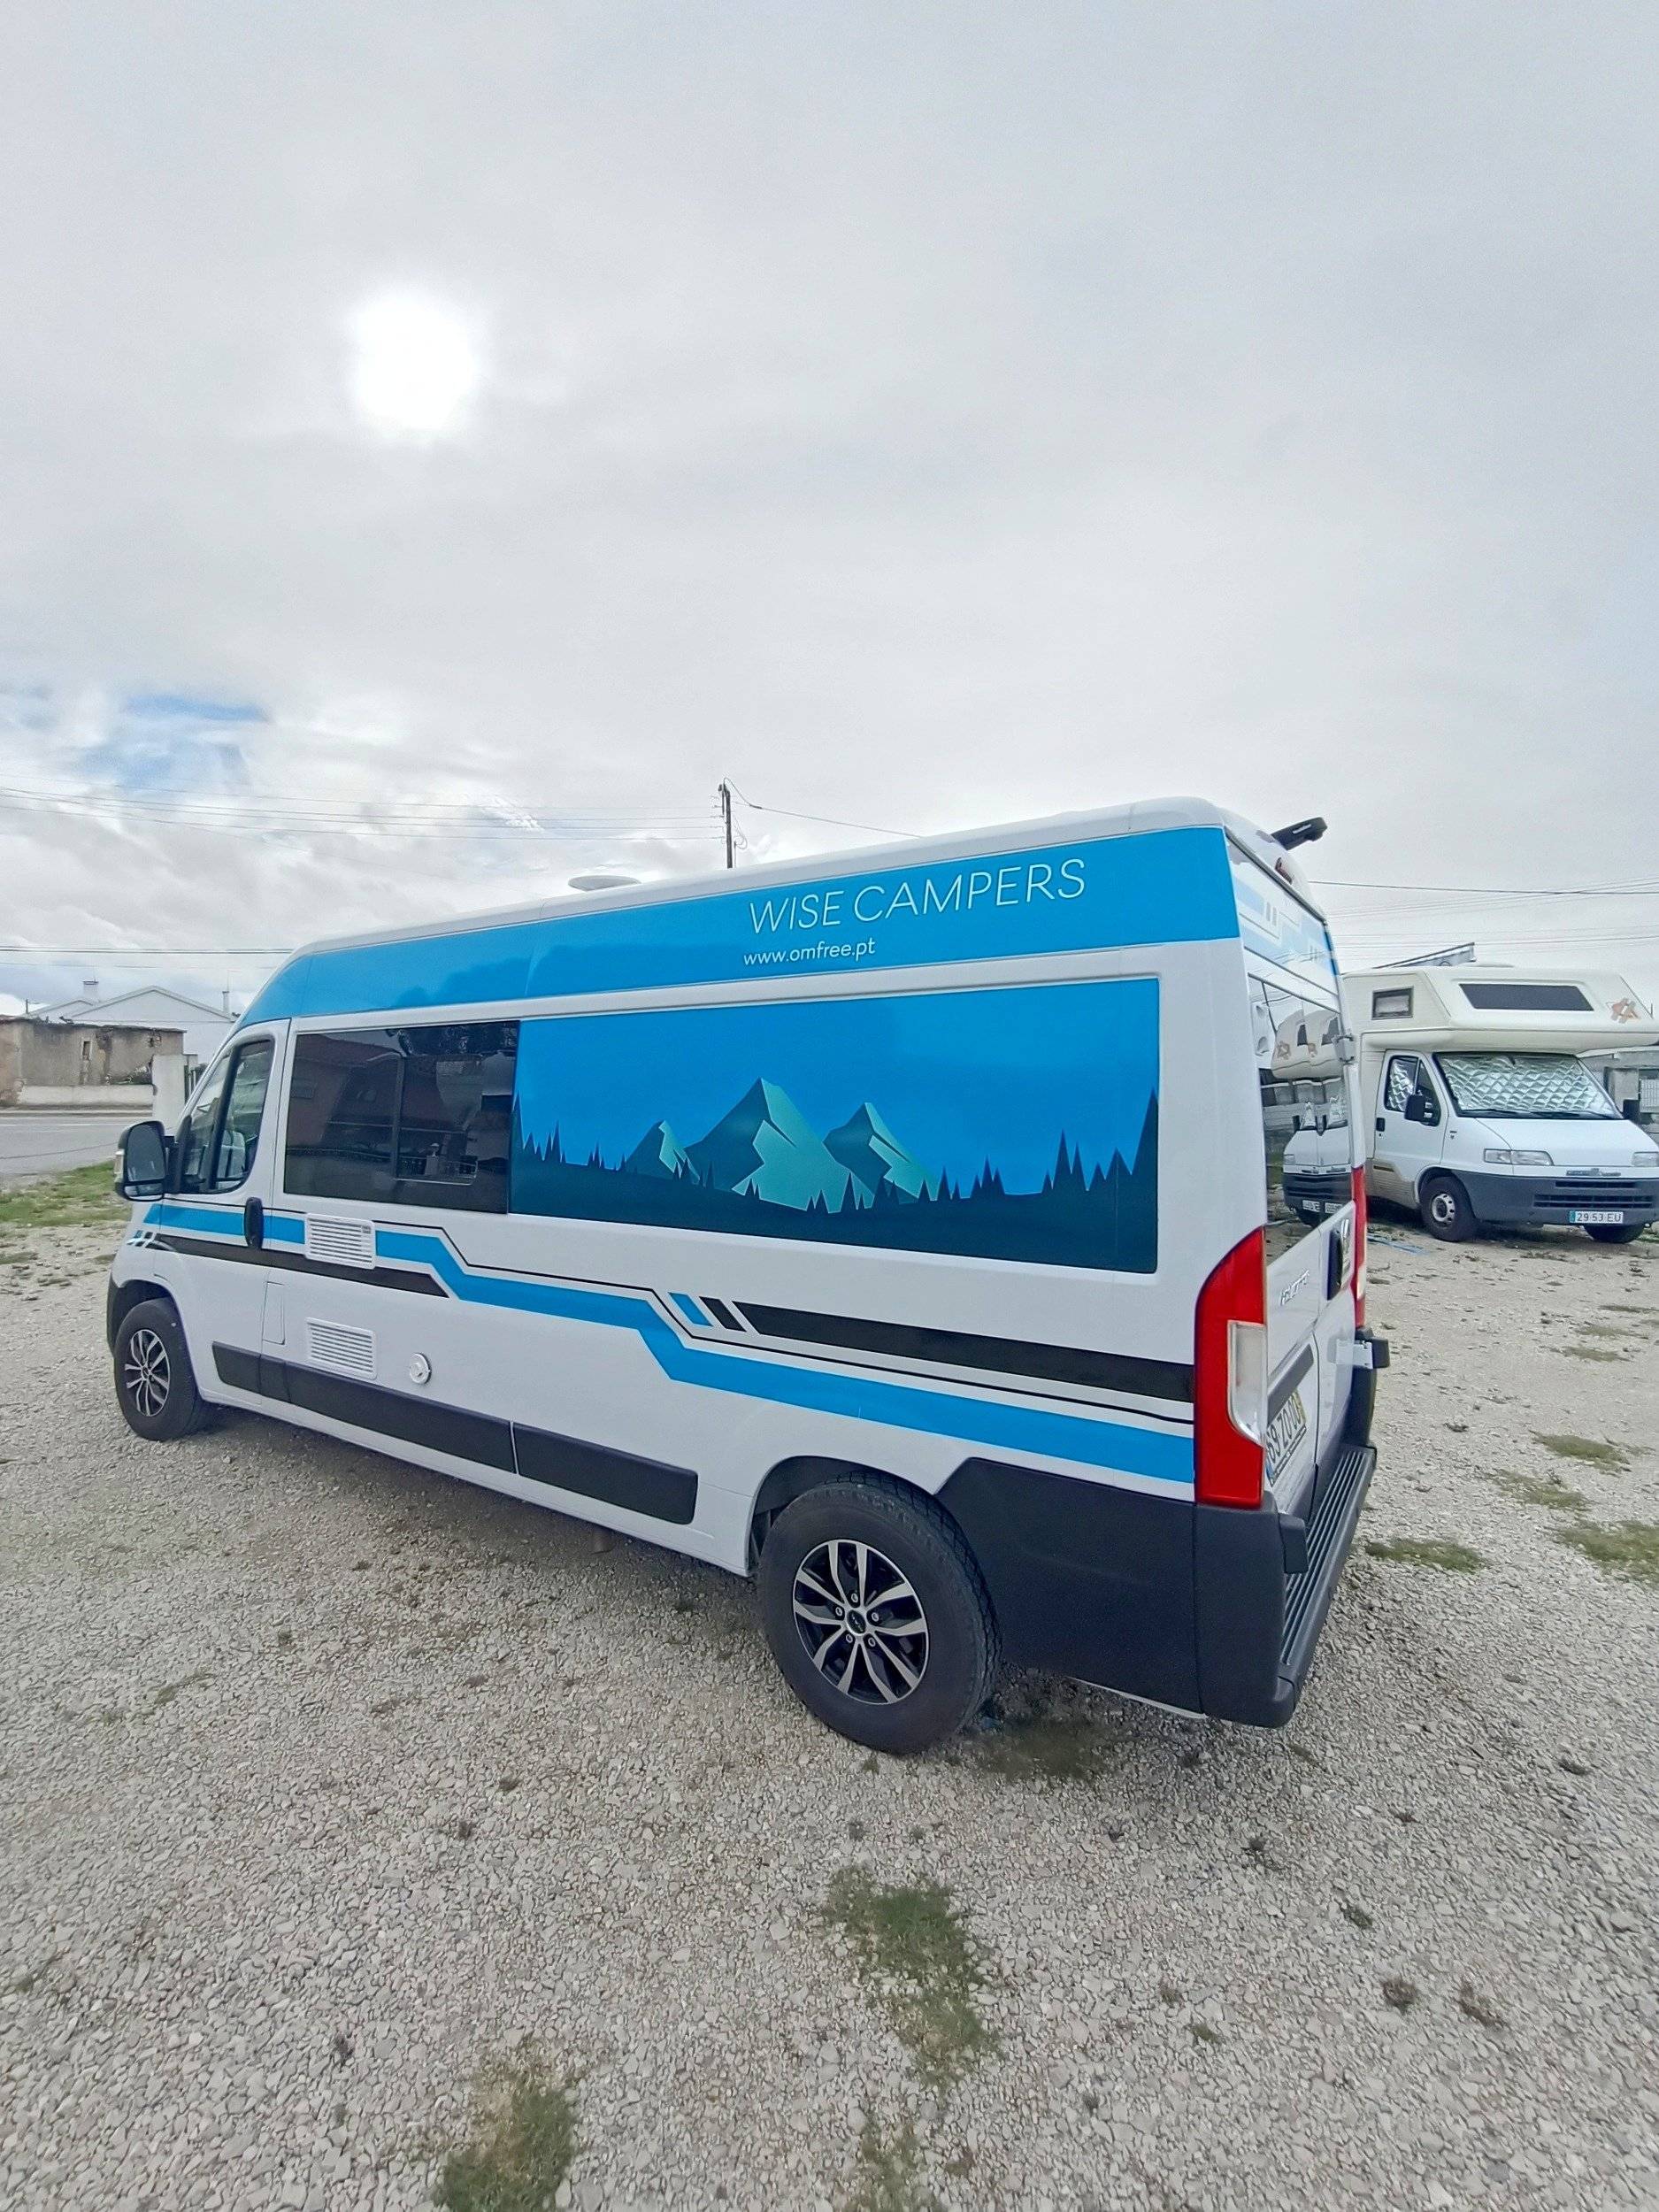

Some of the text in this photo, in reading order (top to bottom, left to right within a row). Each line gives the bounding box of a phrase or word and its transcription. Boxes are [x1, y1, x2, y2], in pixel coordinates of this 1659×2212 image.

[749, 857, 1086, 934] WISE CAMPERS
[743, 936, 876, 965] www.omfree.pt
